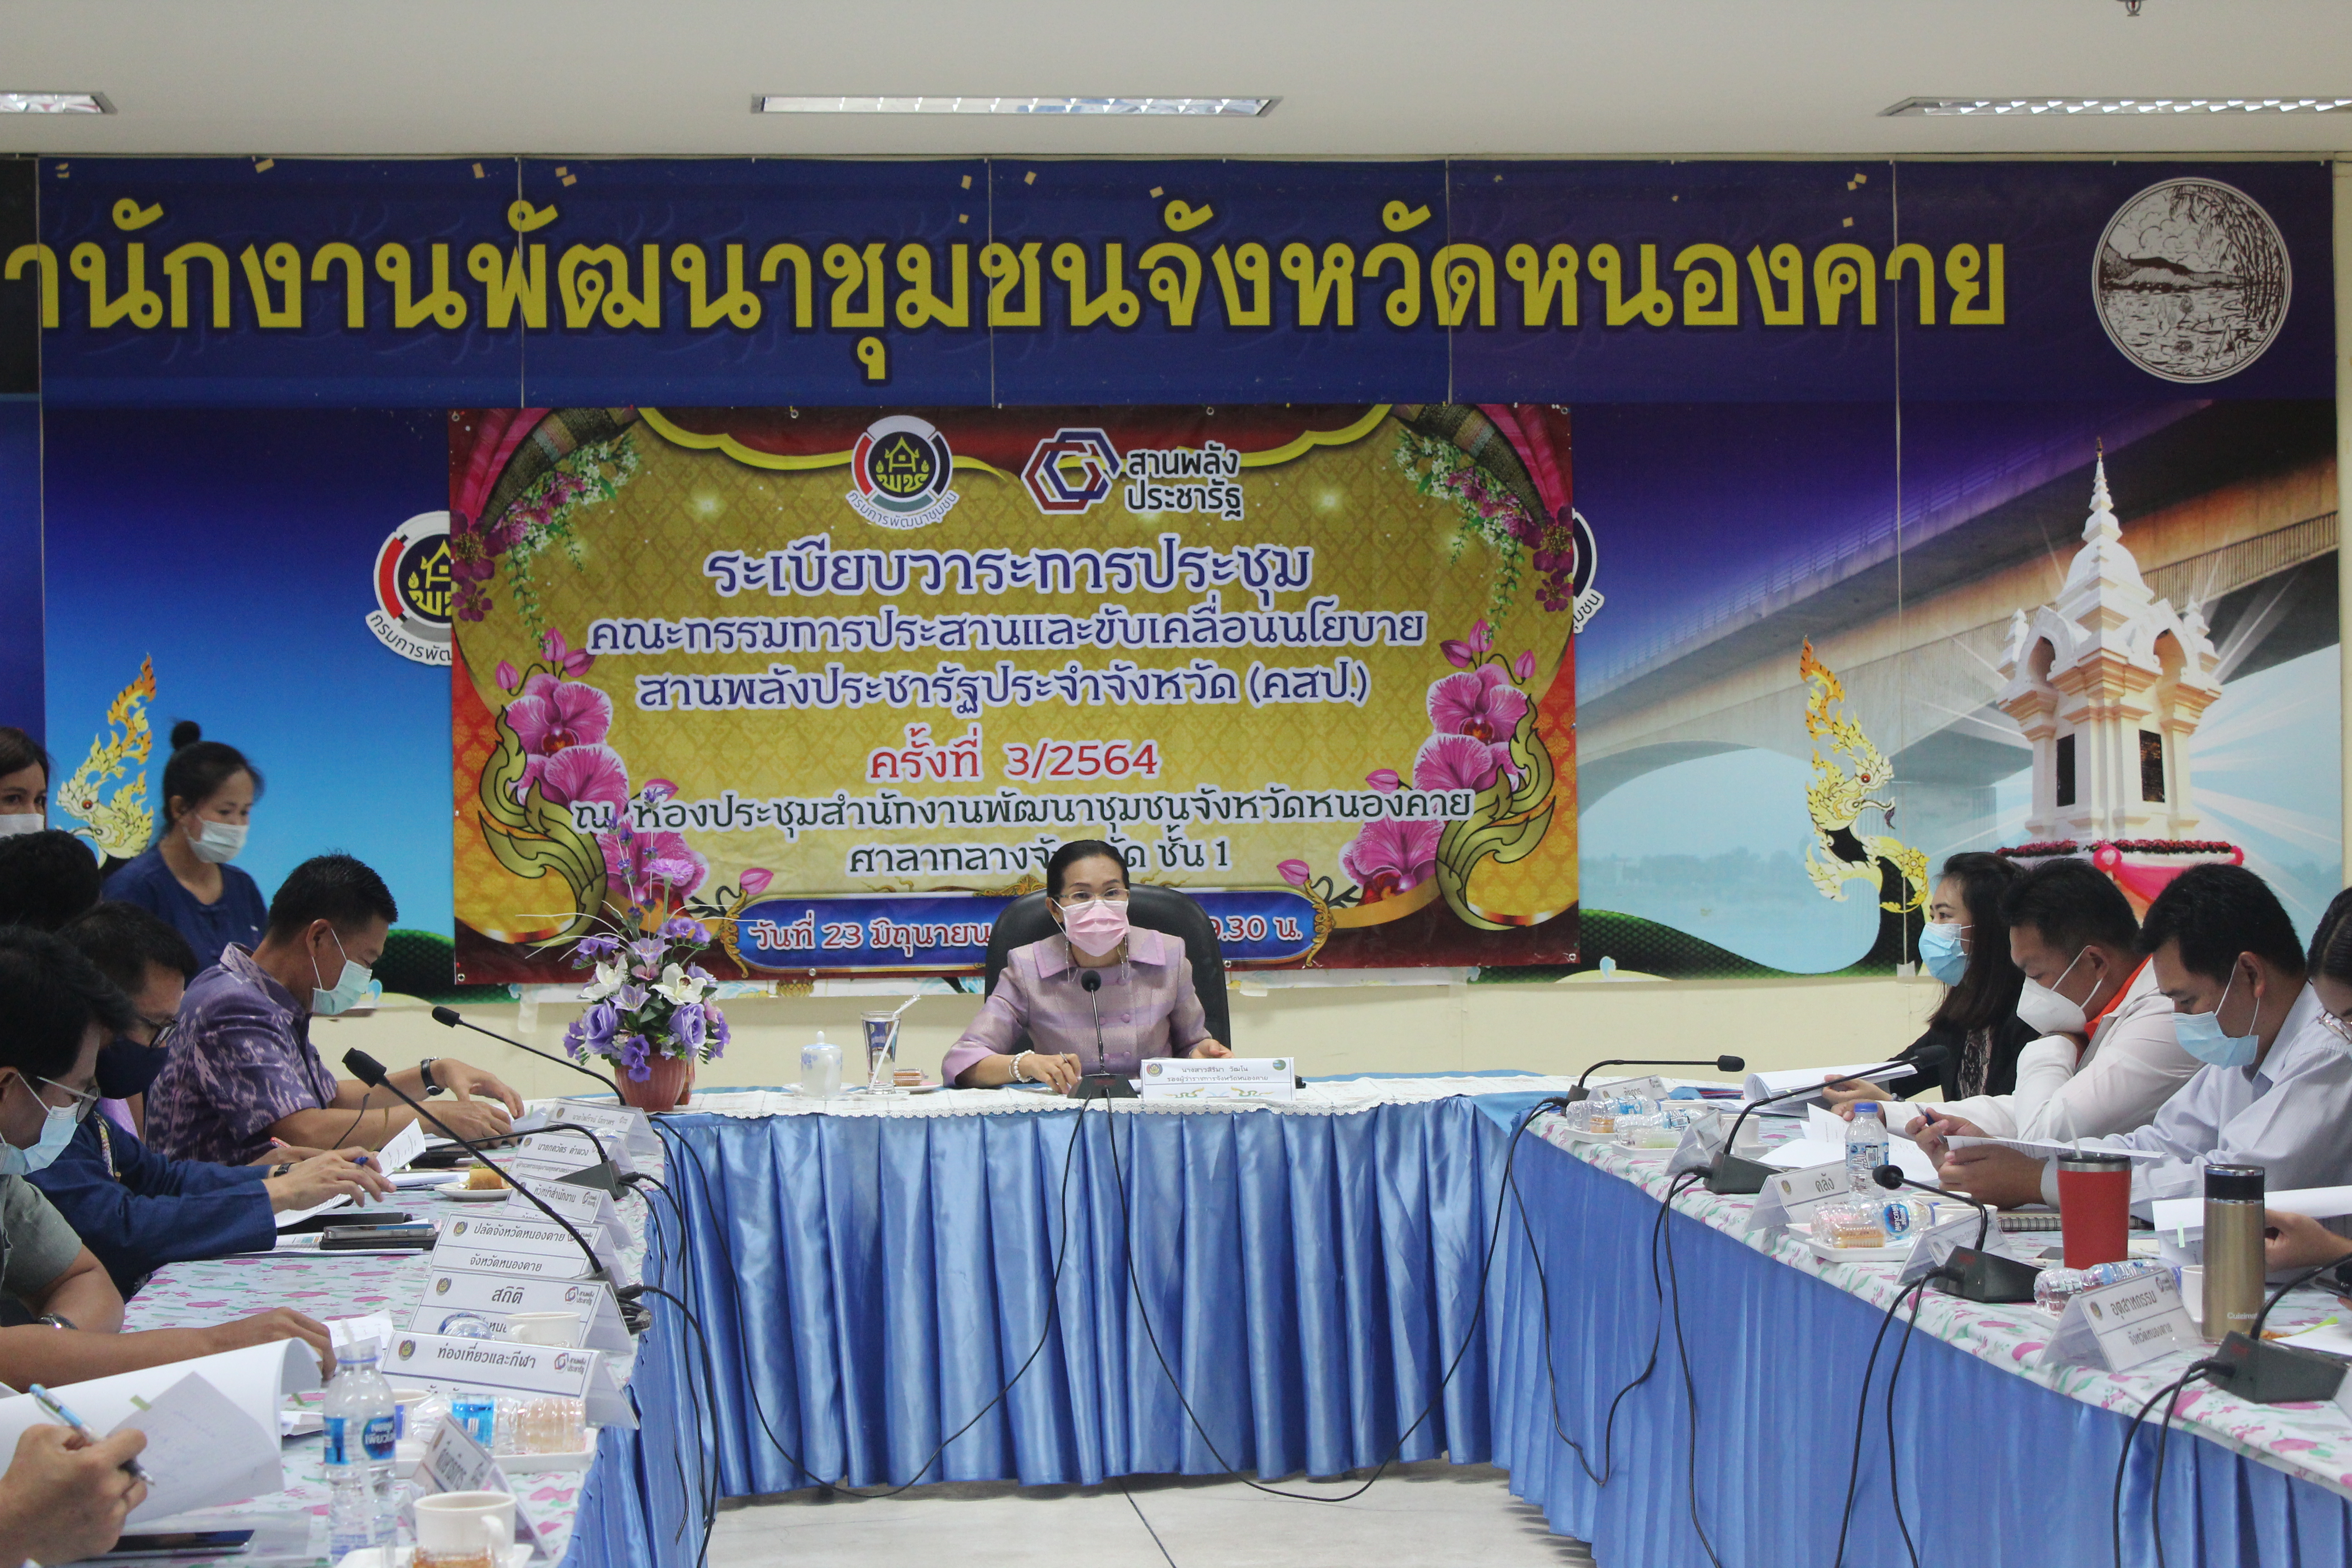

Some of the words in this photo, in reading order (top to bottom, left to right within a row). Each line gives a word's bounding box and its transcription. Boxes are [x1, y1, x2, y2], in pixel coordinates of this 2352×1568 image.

[1129, 444, 1237, 475] สานพลัง
[848, 492, 956, 527] กรมการพัฒนาชุมชน
[1128, 480, 1241, 517] ประชารัฐ
[708, 537, 1310, 607] ระเบียบวาระการประชุม
[591, 594, 1424, 650] คณะกรรมการประสานและขับเคลื่อนนโยบาย
[640, 662, 1236, 714] สานพลังประชารัฐประจำจังหวัด
[871, 728, 978, 779] ครั้งที่
[1008, 742, 1157, 779] 3/2564
[633, 788, 1471, 838] หองประชุมสำนักงานพัฒนาชุมชนจังหวัดหนองคาย
[1158, 824, 1205, 867] ชั้น
[1216, 841, 1228, 866] 1
[751, 912, 813, 947] วันที่
[823, 925, 861, 946] 23
[871, 919, 990, 955] มิถุนายน
[1275, 919, 1300, 938] น.
[1815, 1173, 1835, 1193] คลัง
[474, 1223, 565, 1242] ปลัดจังหวัดหนองคาย
[470, 1253, 543, 1272] จังหวัดหนองคาย
[491, 1285, 525, 1304] สถิติ
[2110, 1290, 2157, 1320] อุตสาหกรรม
[437, 1342, 536, 1369] ท่องเที่ยวและกีฬา
